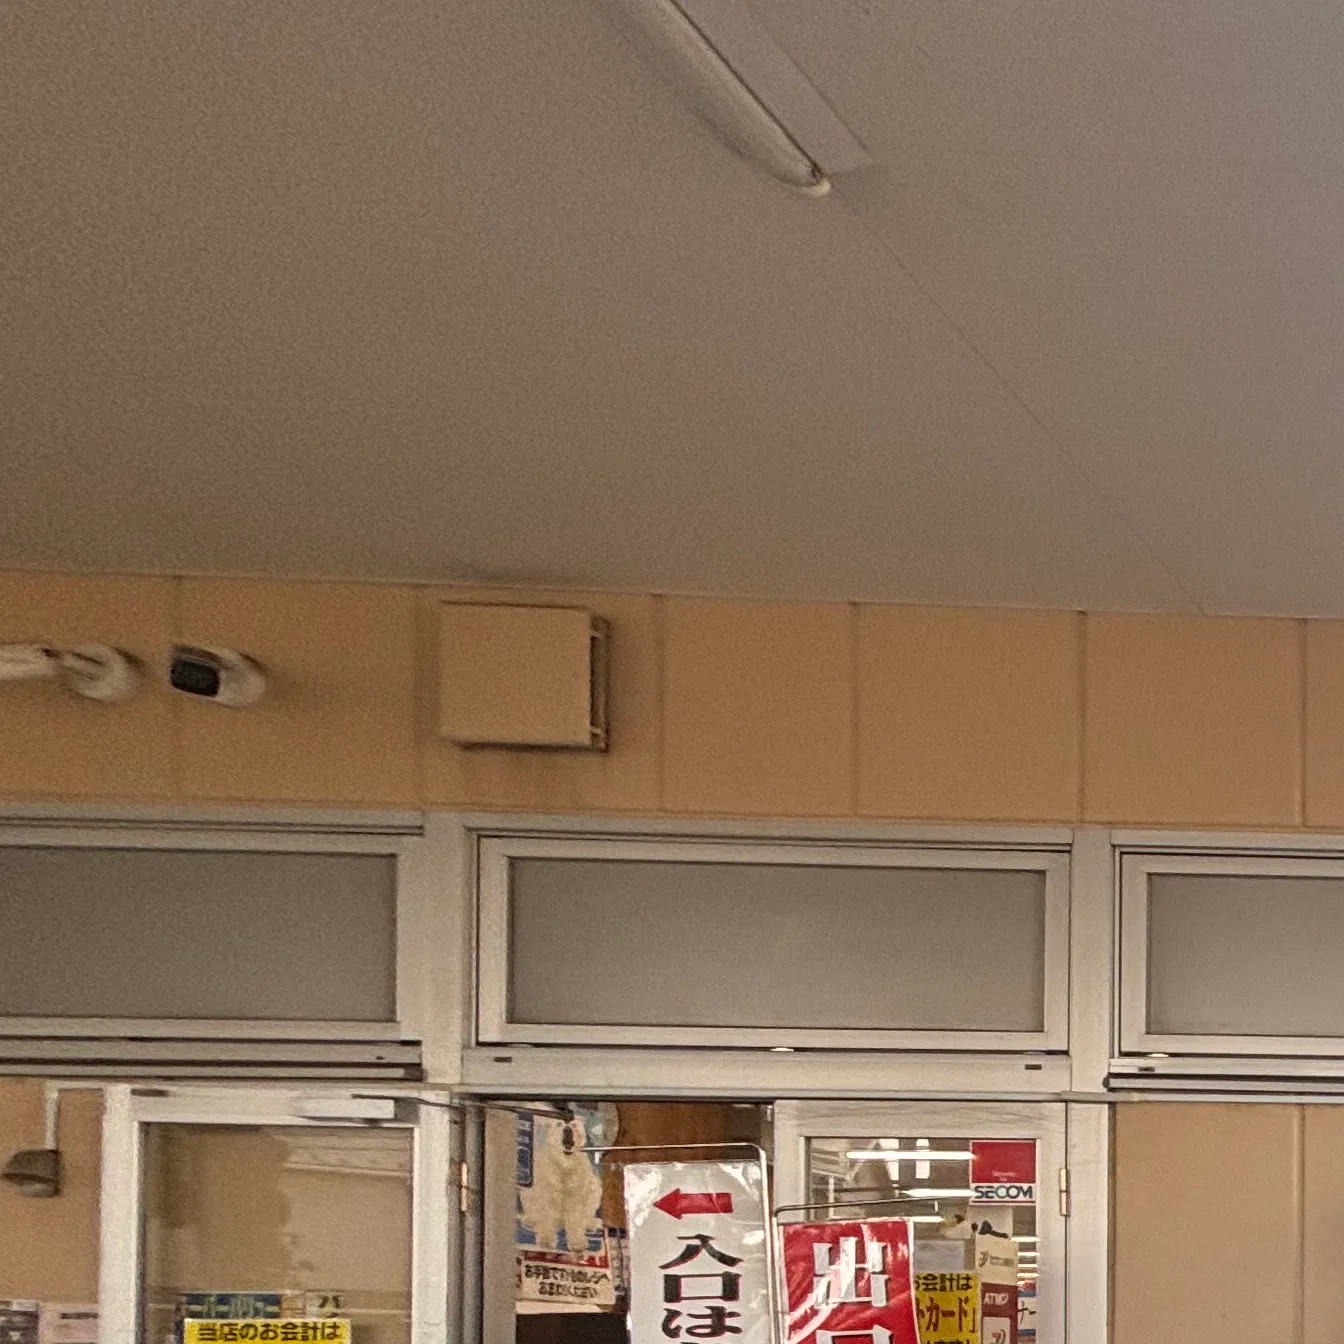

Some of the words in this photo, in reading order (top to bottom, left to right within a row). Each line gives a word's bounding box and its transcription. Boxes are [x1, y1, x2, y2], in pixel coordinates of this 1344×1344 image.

[974, 1185, 1033, 1199] SECOM
[198, 1322, 342, 1343] 当店のお会計は
